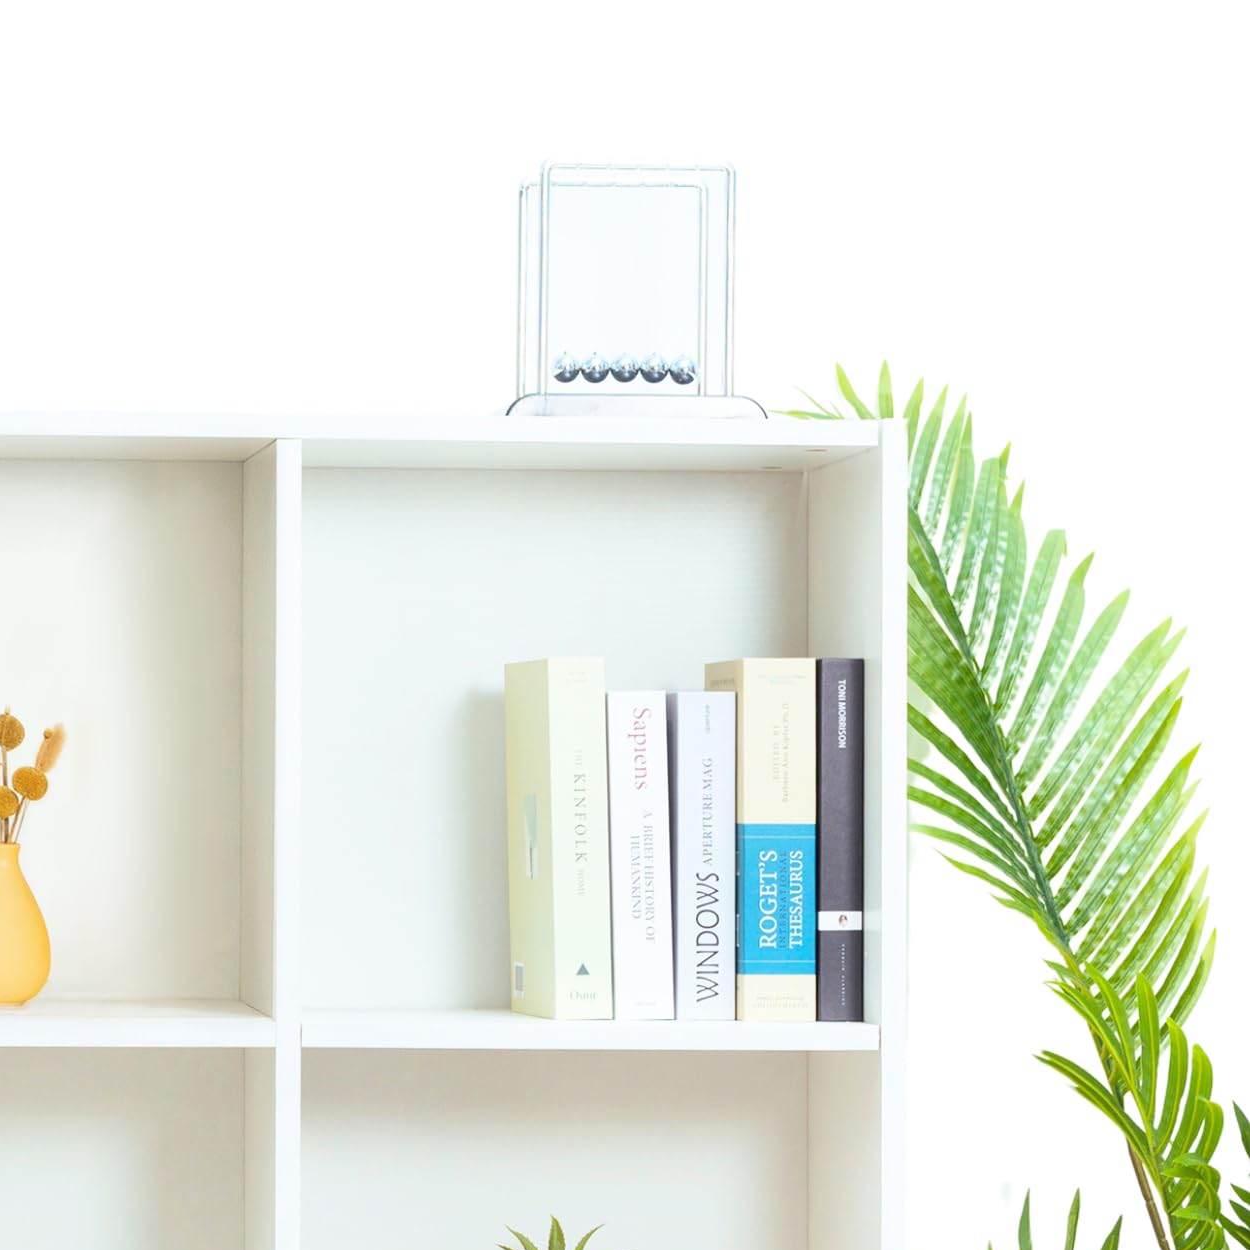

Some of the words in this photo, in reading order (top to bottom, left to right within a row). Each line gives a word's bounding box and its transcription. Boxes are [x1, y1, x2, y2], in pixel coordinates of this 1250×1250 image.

[837, 679, 847, 701] TONI
[837, 702, 847, 749] MORRISON
[627, 707, 652, 790] Sapiens
[573, 773, 588, 863] KINFOLK
[643, 825, 655, 863] BRIEF
[630, 835, 642, 920] HUMANKIND
[644, 864, 655, 922] HISTORY
[758, 849, 779, 949] ROGET'S
[779, 850, 788, 949] INTERNATIONAL
[788, 849, 804, 949] THESAURUS
[645, 926, 656, 945] OF
[695, 872, 720, 1003] WINDOWS
